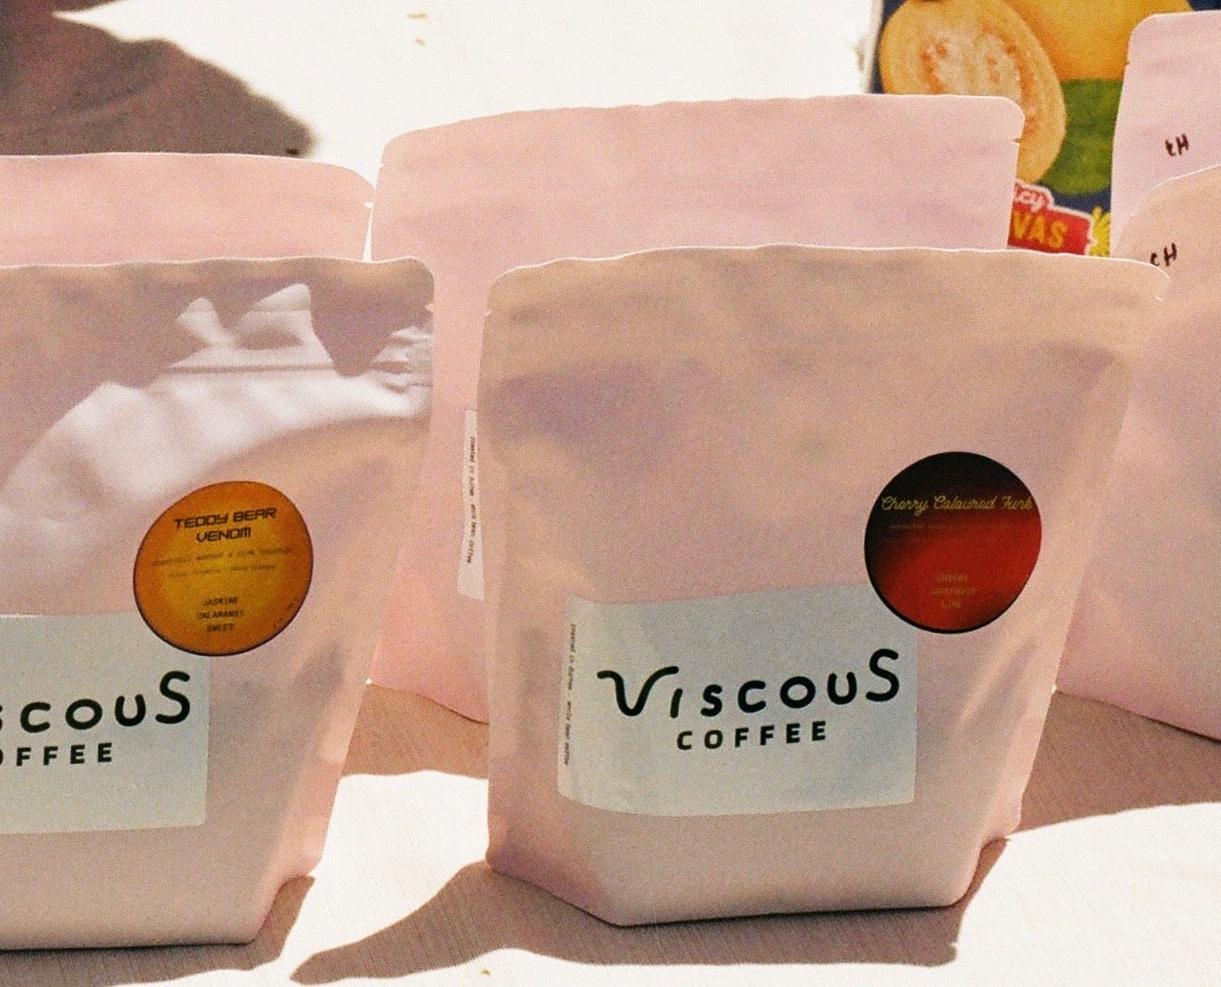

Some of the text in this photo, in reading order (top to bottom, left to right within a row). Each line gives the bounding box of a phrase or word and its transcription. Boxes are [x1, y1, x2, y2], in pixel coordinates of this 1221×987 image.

[881, 495, 929, 517] Cherry
[1001, 495, 1035, 511] Funk
[173, 507, 278, 530] TEDDY BEAR
[196, 527, 252, 543] VENOM
[677, 720, 827, 751] COFFEE
